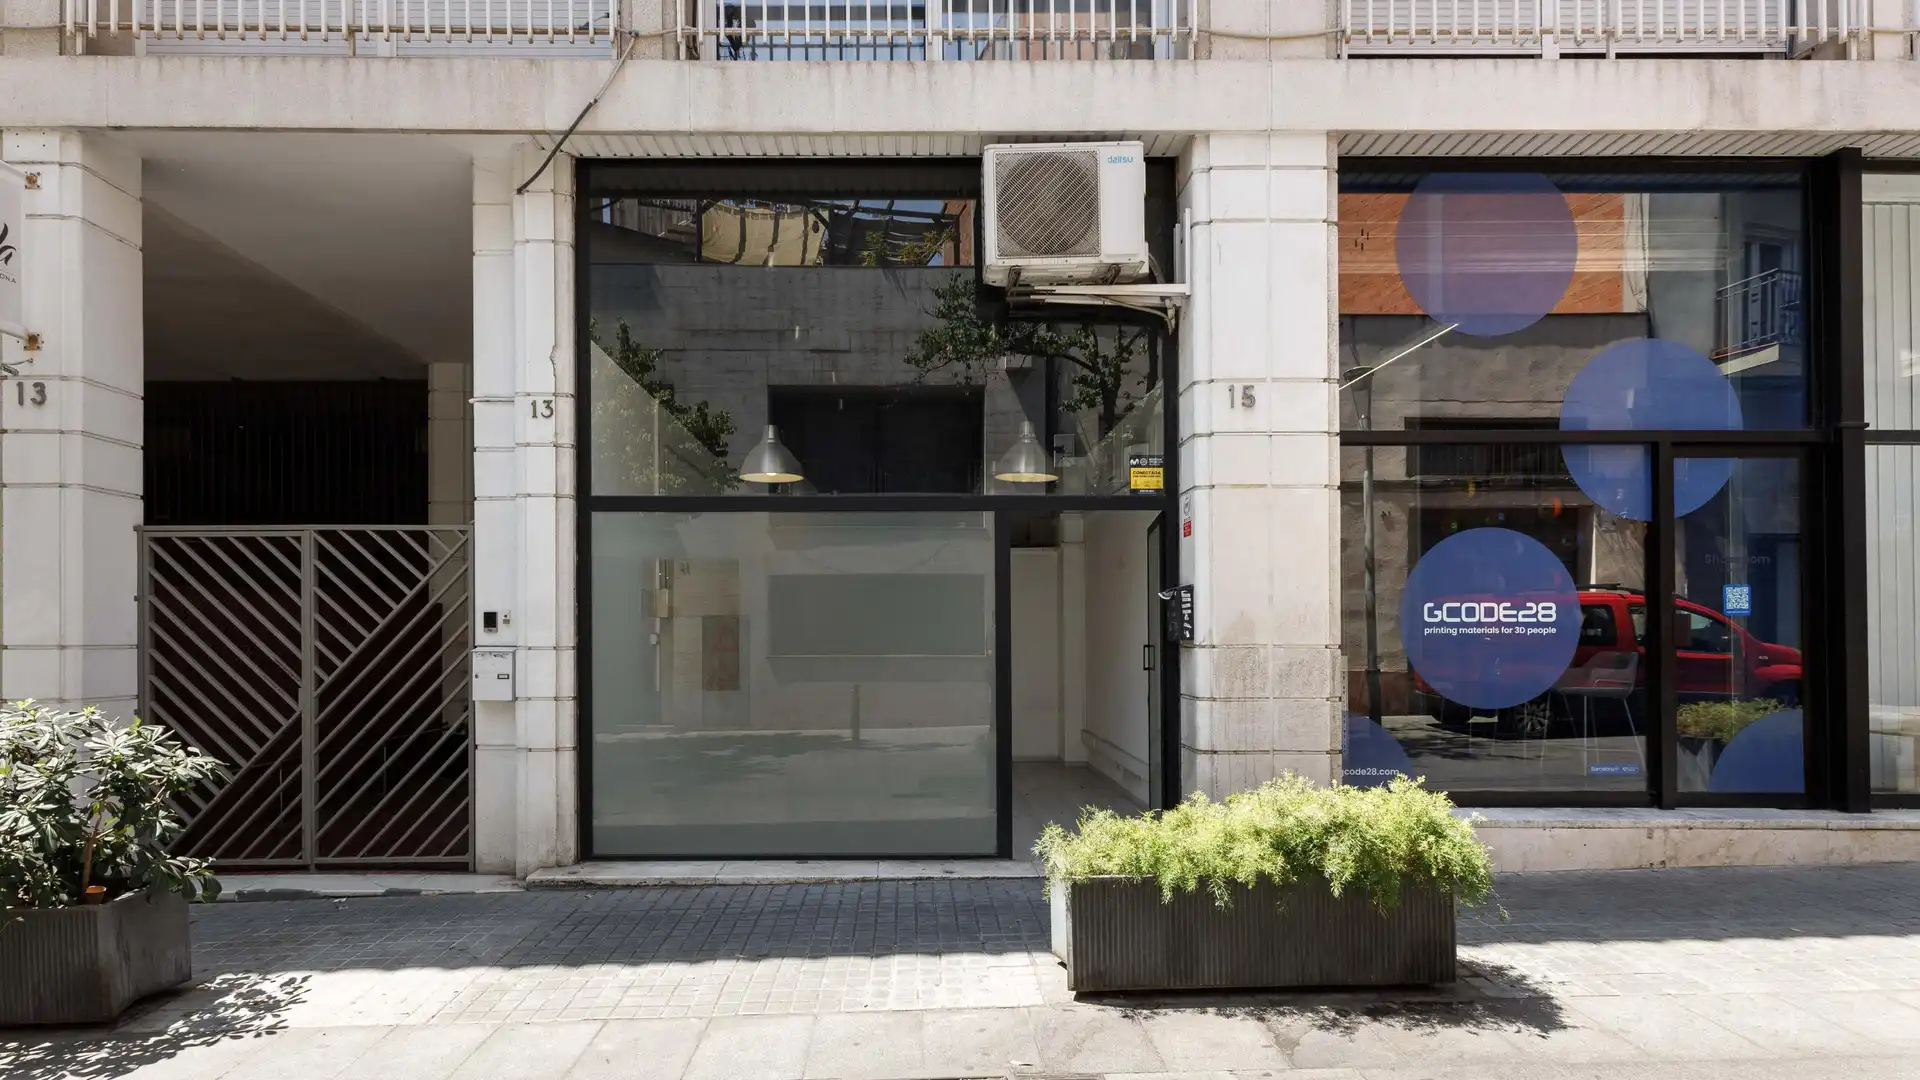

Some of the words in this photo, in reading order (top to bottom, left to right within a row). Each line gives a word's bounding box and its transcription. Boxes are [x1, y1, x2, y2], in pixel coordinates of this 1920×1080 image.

[17, 381, 47, 406] 13
[1228, 384, 1256, 409] 15
[530, 399, 554, 418] 13
[1423, 602, 1557, 622] GCODE28
[1424, 626, 1458, 636] printing
[1459, 626, 1500, 634] materials
[1501, 626, 1513, 634] for
[1514, 626, 1526, 634] 3D
[1527, 626, 1557, 636] people
